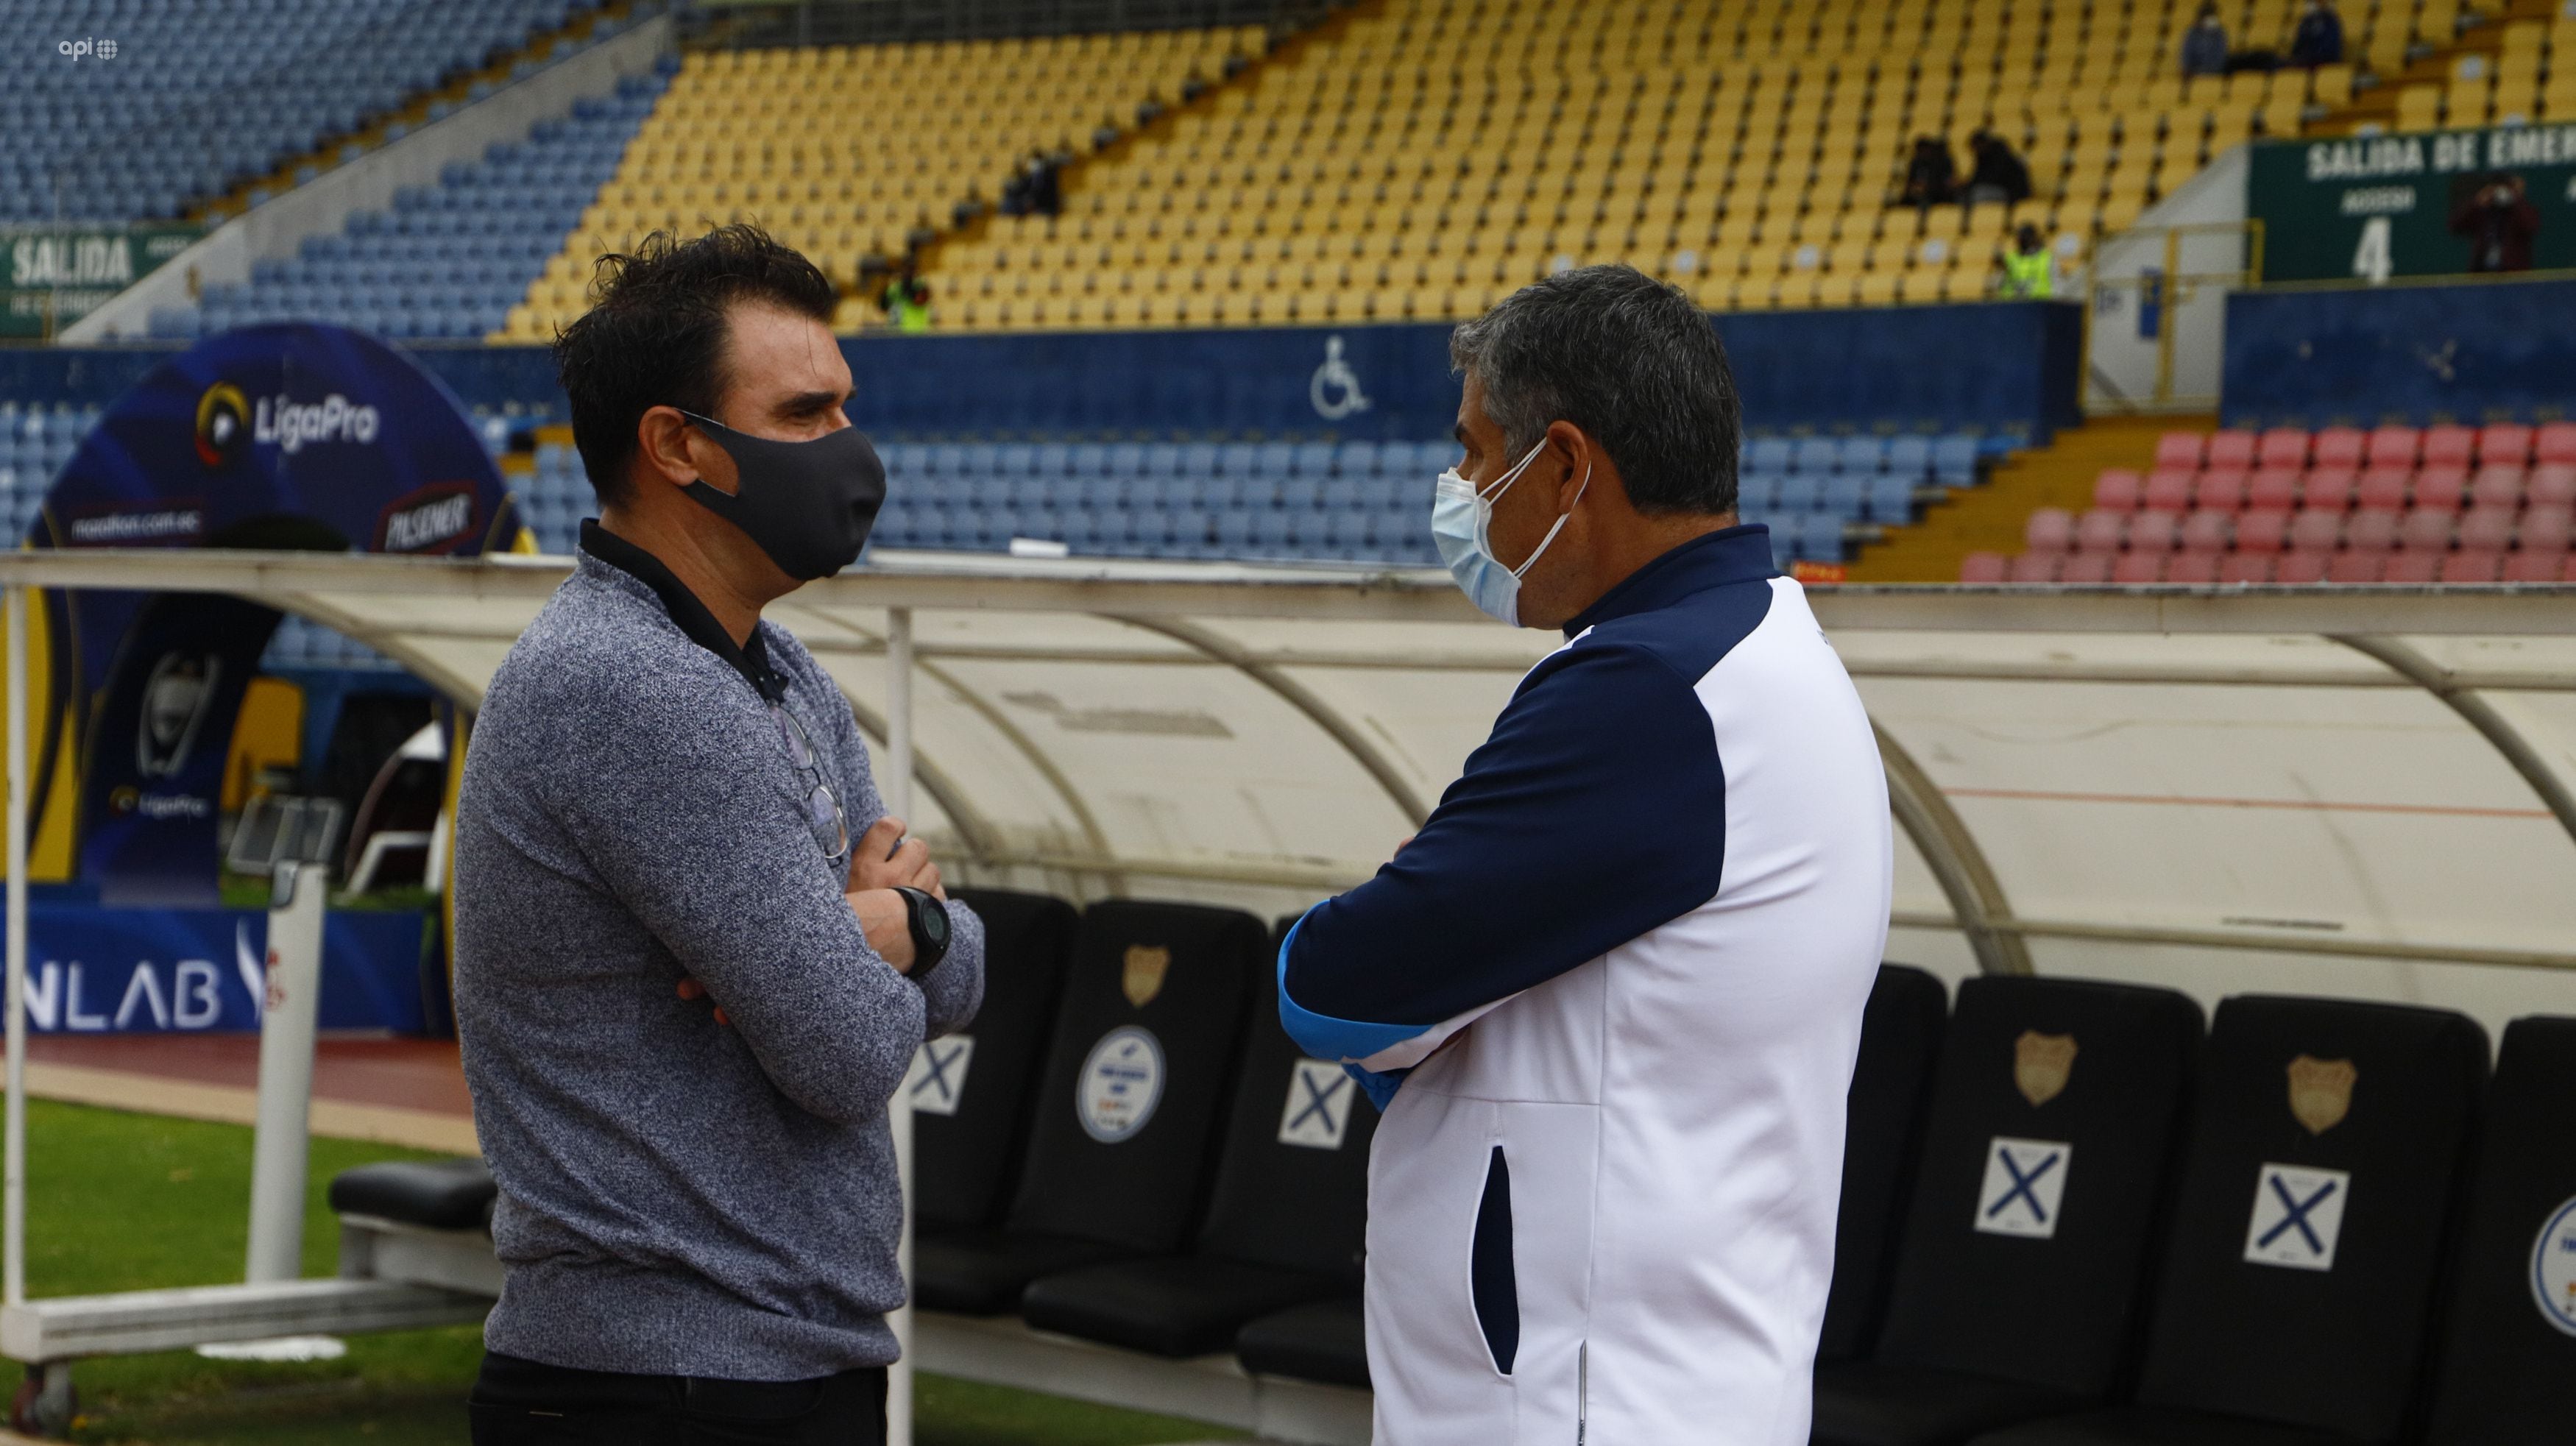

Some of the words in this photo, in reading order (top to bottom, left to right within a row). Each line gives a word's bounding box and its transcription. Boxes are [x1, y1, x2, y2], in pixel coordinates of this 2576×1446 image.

[2307, 135, 2426, 182] SALIDA
[2432, 131, 2479, 174] DE
[10, 235, 132, 287] SALIDA
[2352, 216, 2392, 286] 4
[254, 392, 380, 456] LigaPro
